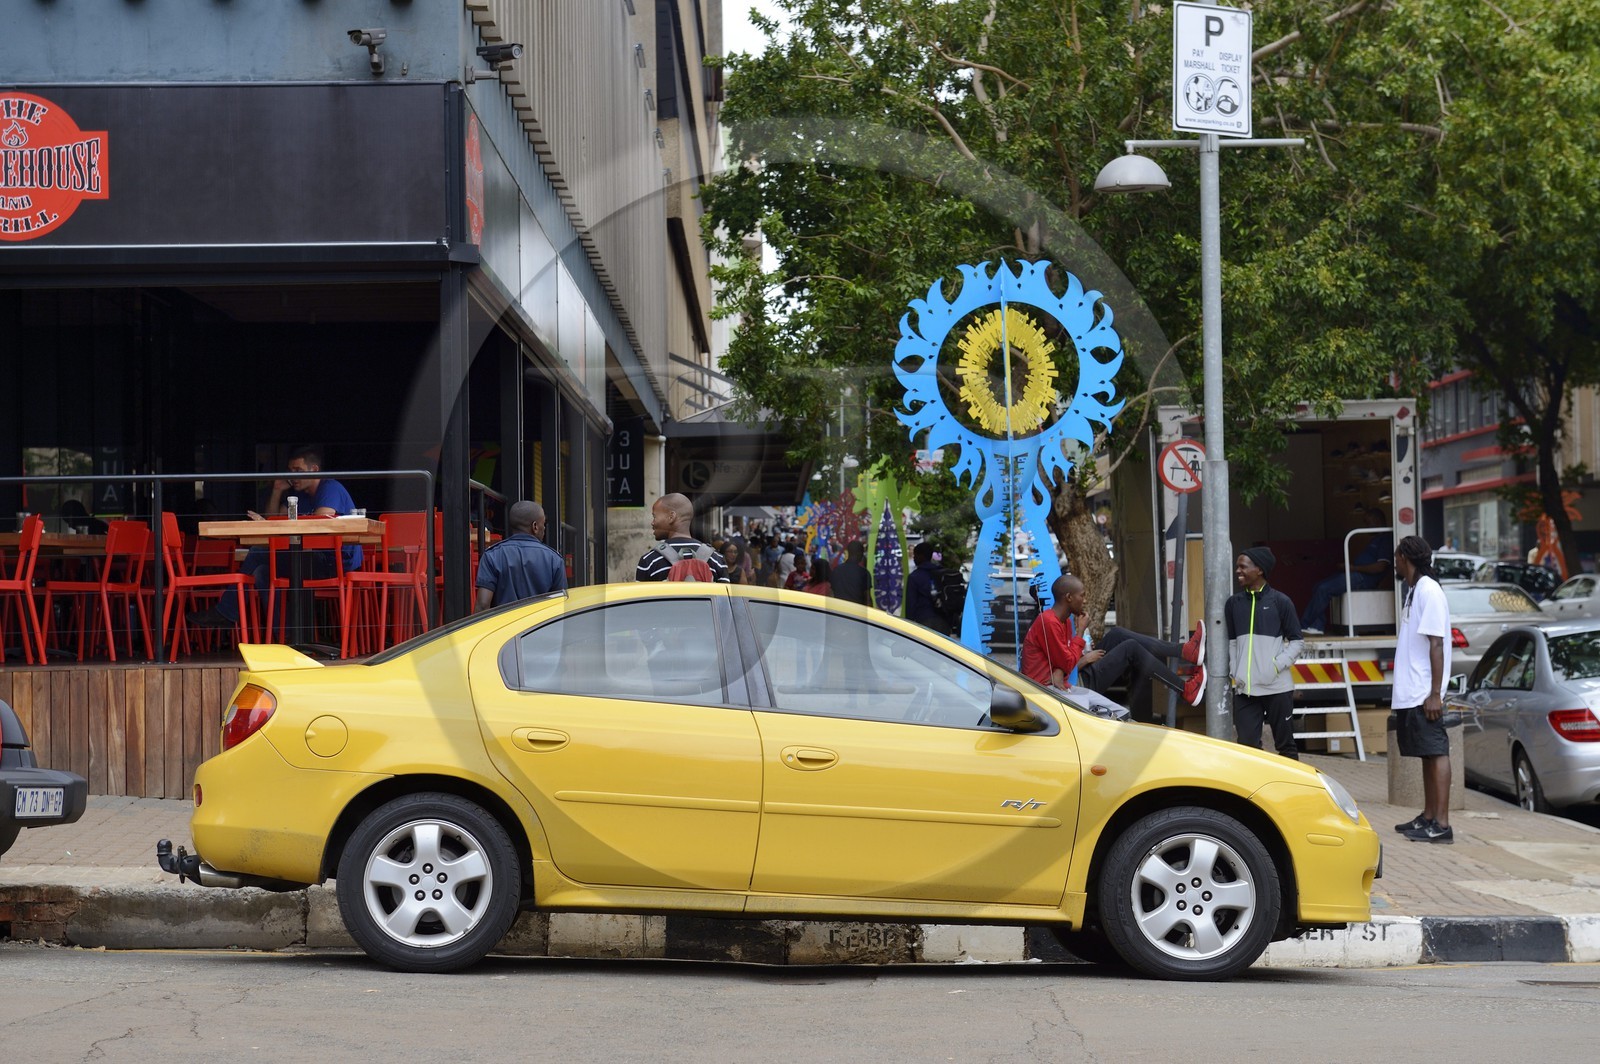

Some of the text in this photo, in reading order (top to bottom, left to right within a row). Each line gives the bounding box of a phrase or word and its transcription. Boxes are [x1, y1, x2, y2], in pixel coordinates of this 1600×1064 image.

[1205, 15, 1224, 47] P
[1192, 48, 1204, 57] PAY
[1219, 51, 1243, 62] DISPLAY
[1184, 60, 1215, 71] MARSHALL
[1221, 63, 1240, 74] TICKET
[0, 98, 48, 126] HE
[0, 137, 101, 195] EHOUSE
[1000, 798, 1047, 811] R/T
